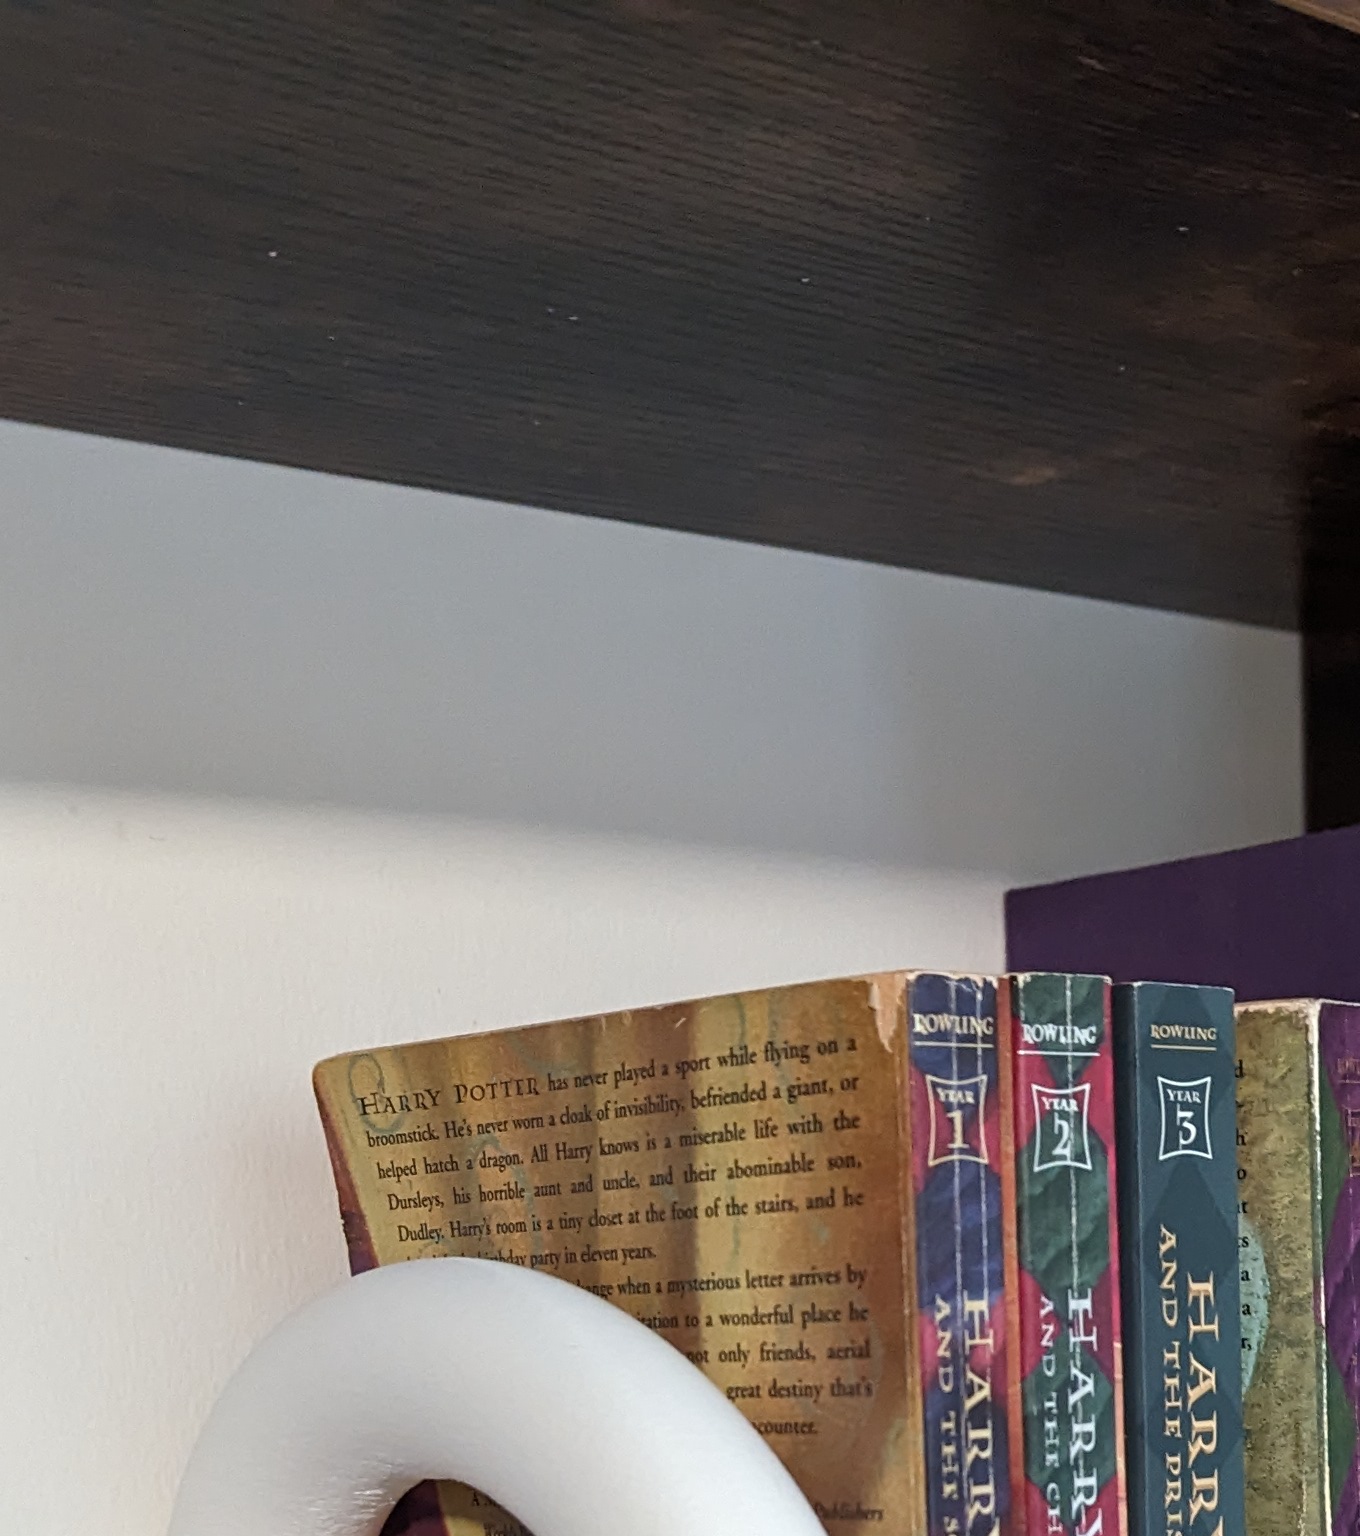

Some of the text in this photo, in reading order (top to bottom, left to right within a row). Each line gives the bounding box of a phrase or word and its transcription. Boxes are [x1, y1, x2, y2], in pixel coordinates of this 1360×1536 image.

[913, 1012, 994, 1036] ROWLING
[1021, 1023, 1097, 1046] ROWLING
[1150, 1023, 1217, 1041] ROWLING
[359, 1040, 838, 1116] HARRY POTTER has never played sport while flying on
[937, 1088, 975, 1104] YEAR
[1167, 1089, 1201, 1103] YEAR
[366, 1076, 859, 1148] broomstick. He's never worn cloak of invisibility, befriended giant, or
[1042, 1097, 1079, 1112] YEAR
[376, 1110, 861, 1183] helped hatch dragon. All Harry knows miserable life with the
[946, 1110, 969, 1149] 1
[1052, 1114, 1073, 1160] 2
[387, 1152, 815, 1214] Dursleys, his horrible aunt and uncle, and their abominable
[398, 1186, 865, 1245] Dudley. Harry's room tiny closet the foot of the stairs, and he
[530, 1251, 560, 1269] party
[581, 1247, 618, 1264] eleven
[621, 1247, 657, 1269] years.
[1159, 1223, 1179, 1329] AND
[617, 1264, 866, 1297] when mysterious letter arrives by
[720, 1301, 869, 1329] wonderful place he
[718, 1339, 871, 1368] only friends, aerial
[935, 1294, 953, 1393] AND
[1039, 1295, 1061, 1378] AND
[726, 1376, 874, 1403] great destiny that's
[1163, 1341, 1183, 1439] THE
[1043, 1391, 1061, 1469] THE
[941, 1410, 959, 1500] THE
